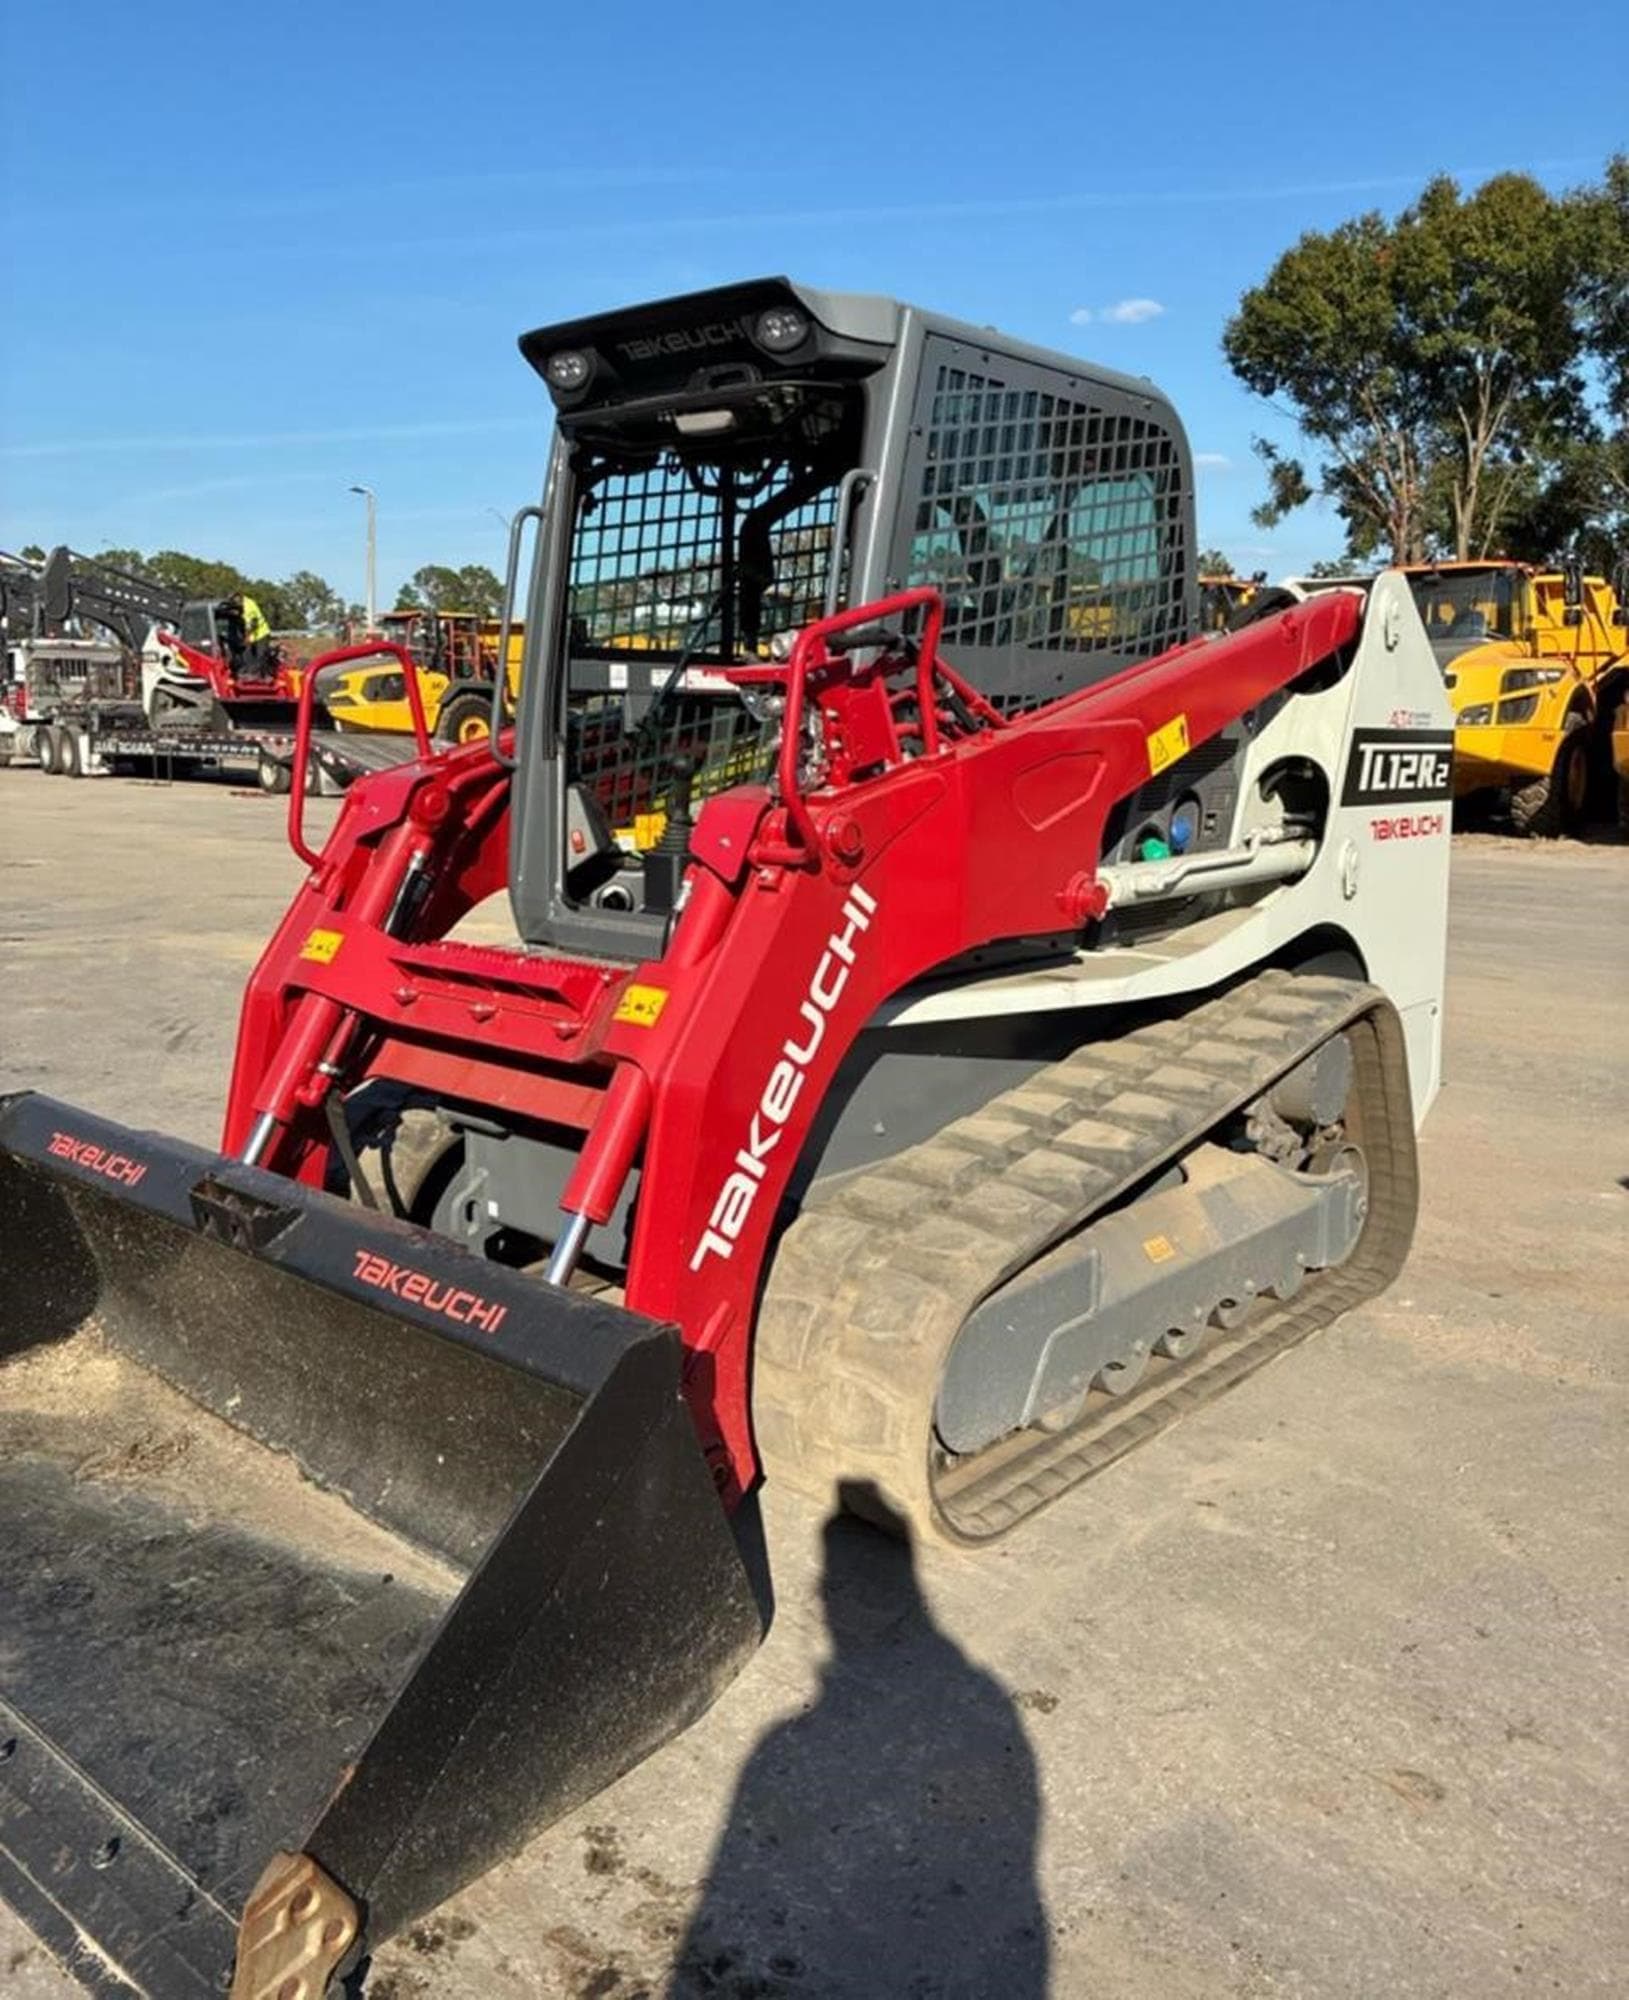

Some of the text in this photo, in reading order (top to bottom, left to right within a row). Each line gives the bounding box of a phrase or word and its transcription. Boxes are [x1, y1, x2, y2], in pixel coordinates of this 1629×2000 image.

[616, 320, 746, 361] TAKEUCH
[689, 882, 878, 1272] TAKEUCHI
[47, 1131, 149, 1187] TAKEUCHI
[352, 1250, 508, 1334] TAKEUCHI
